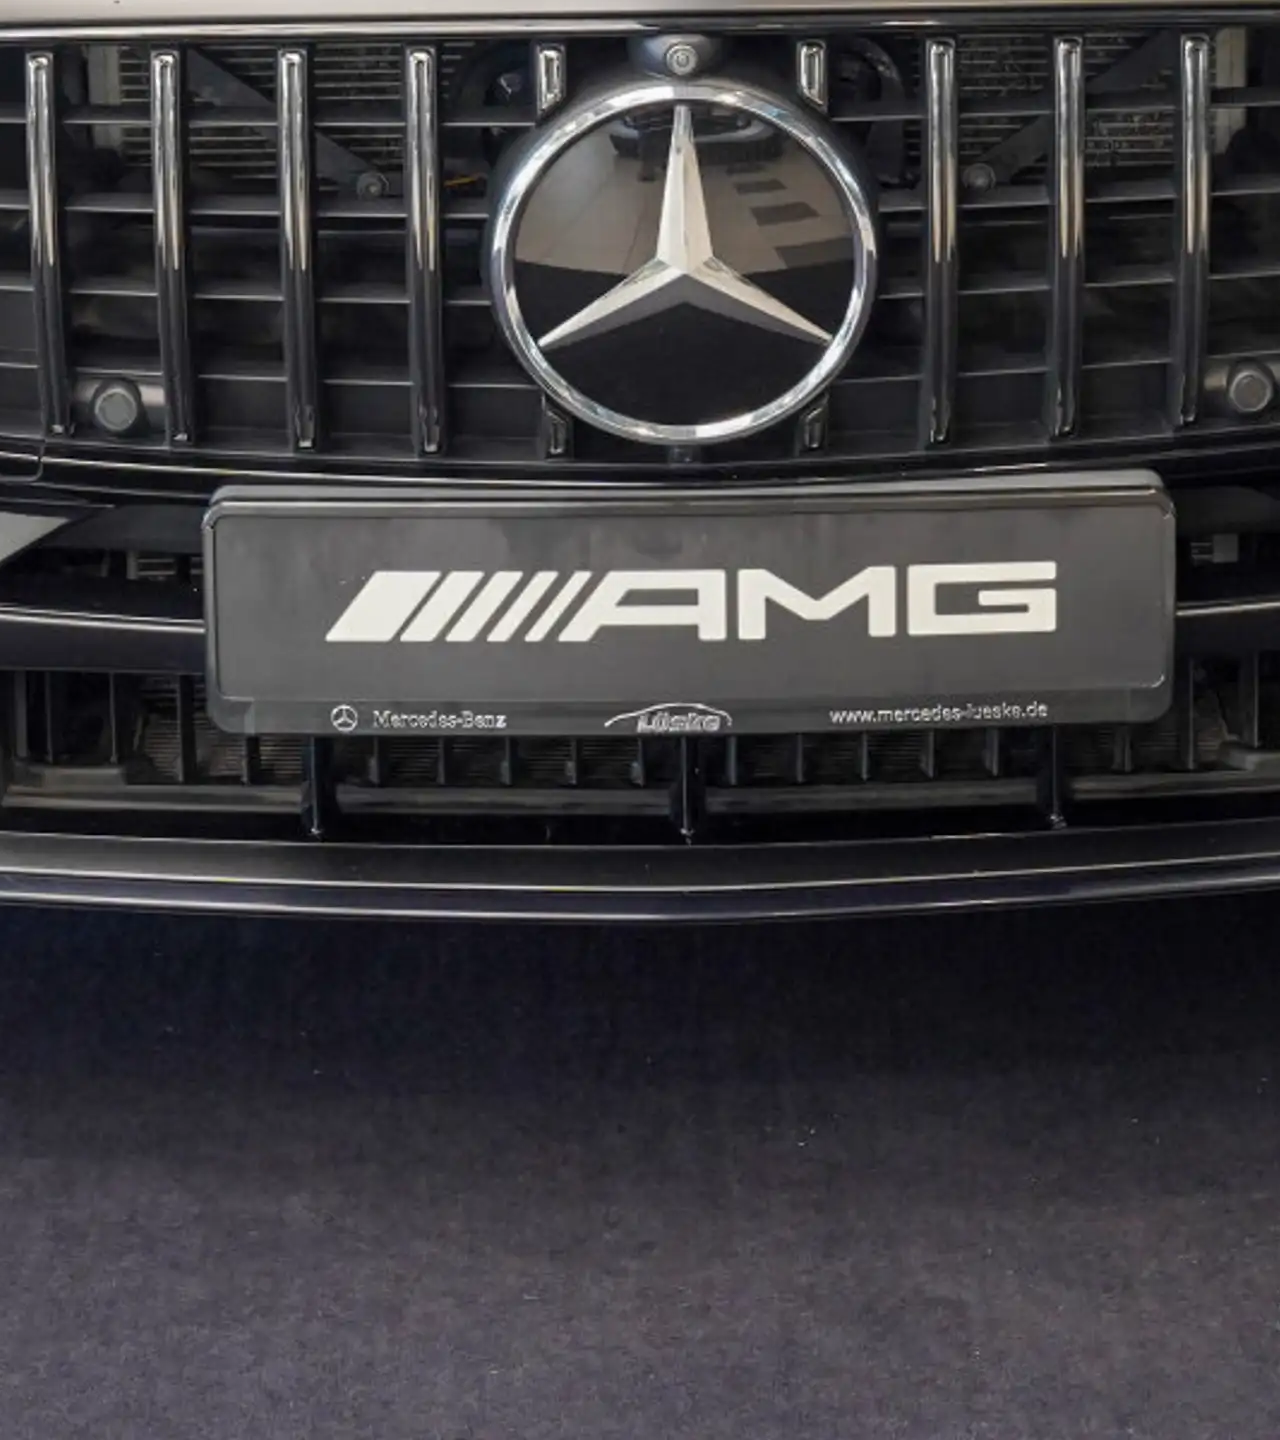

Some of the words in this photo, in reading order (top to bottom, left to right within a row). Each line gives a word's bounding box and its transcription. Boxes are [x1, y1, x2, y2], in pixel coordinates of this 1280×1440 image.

[558, 561, 1057, 641] AMG
[372, 710, 507, 729] Mercedes-Benz
[829, 701, 1049, 724] www.mercedes-lueske.de
